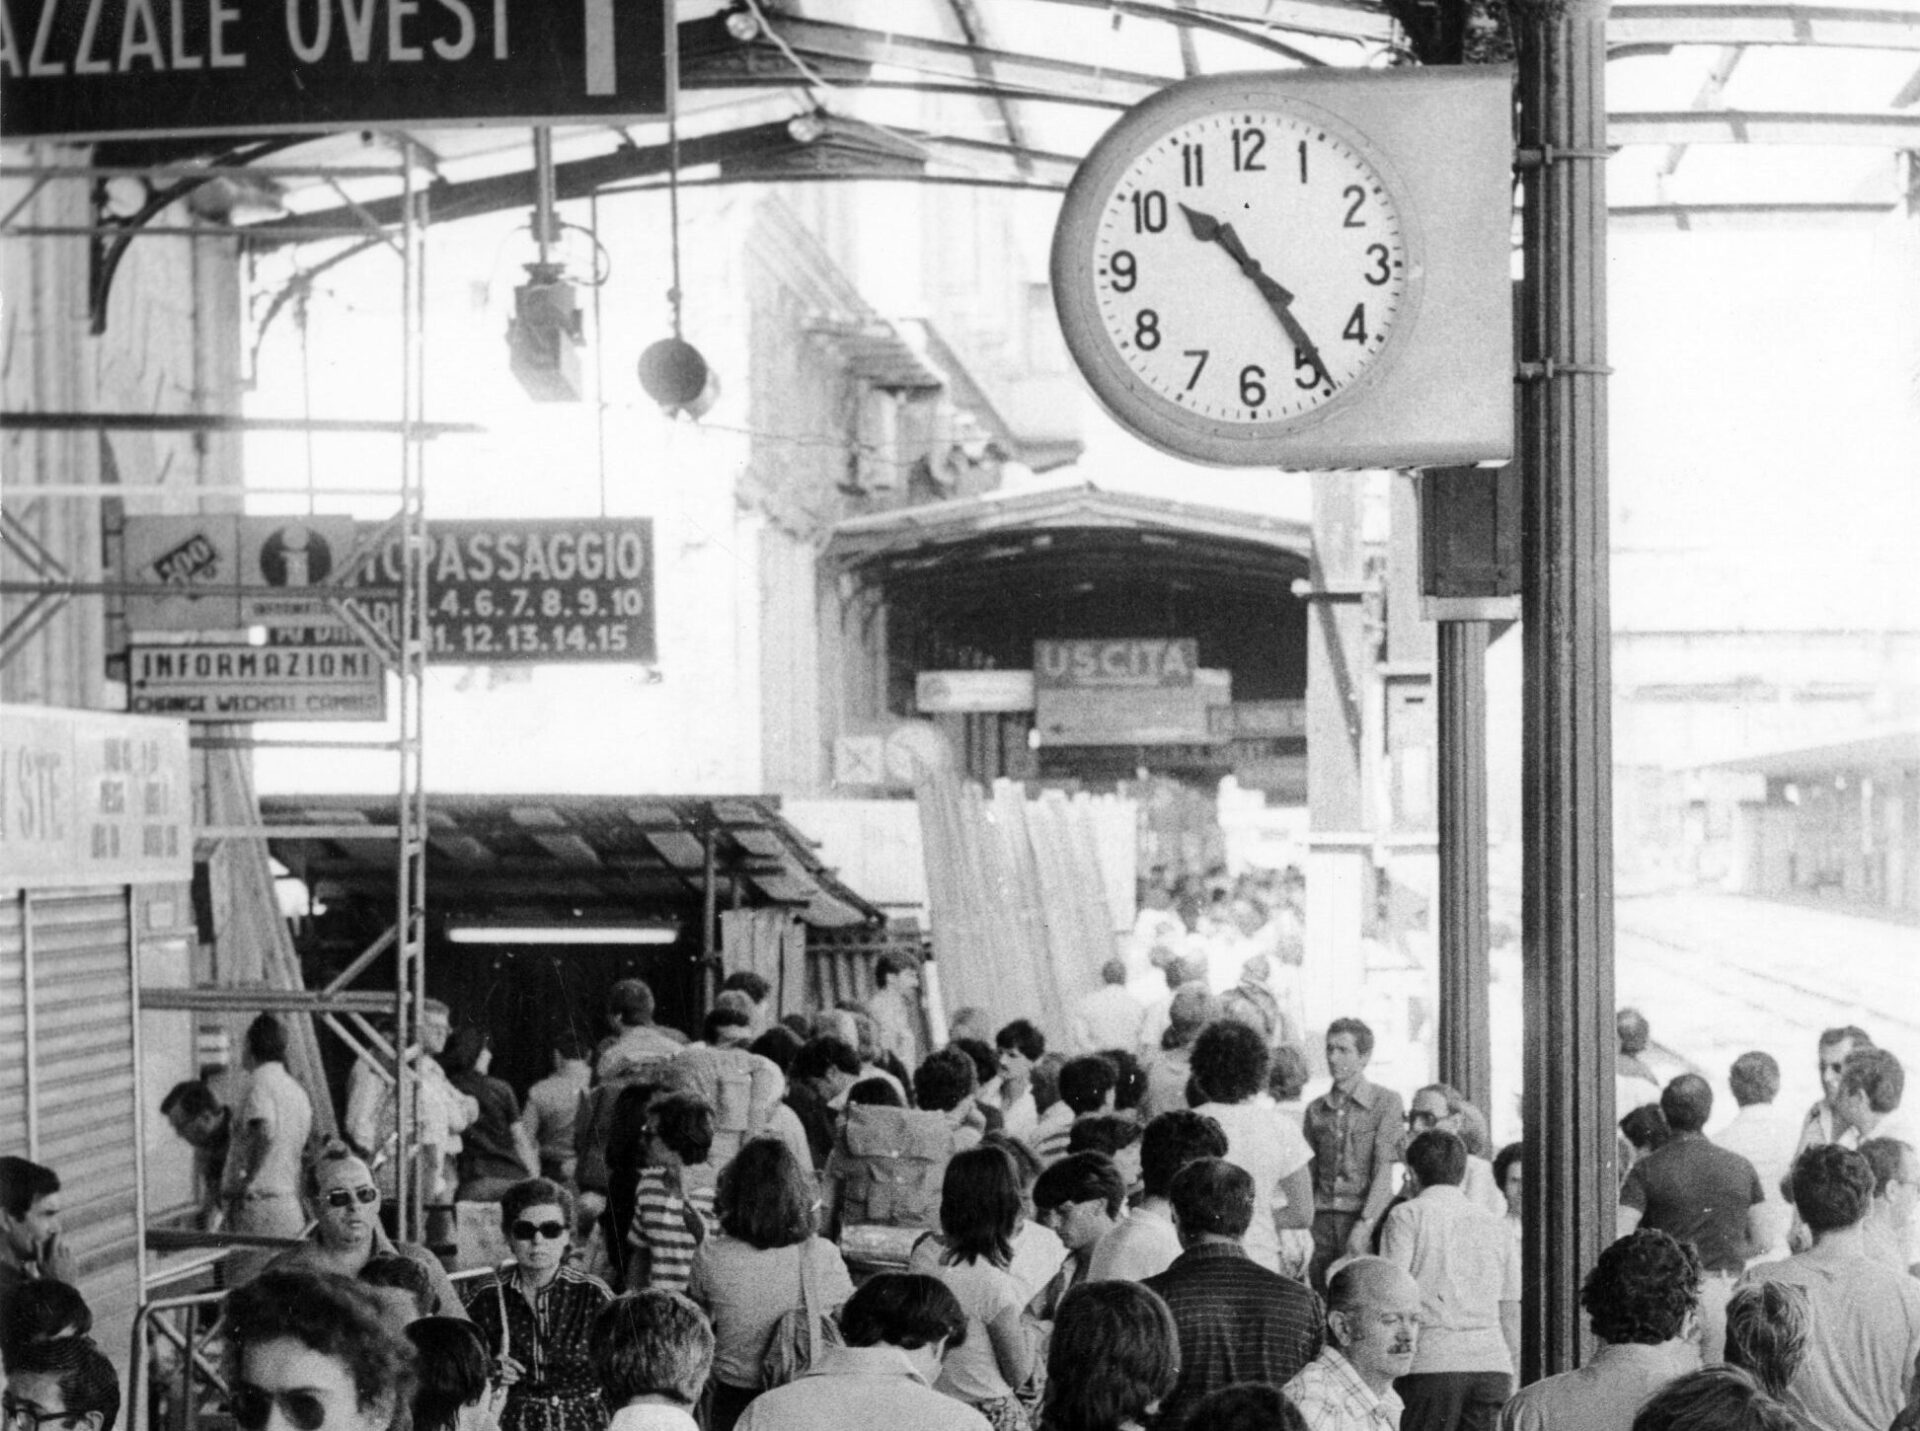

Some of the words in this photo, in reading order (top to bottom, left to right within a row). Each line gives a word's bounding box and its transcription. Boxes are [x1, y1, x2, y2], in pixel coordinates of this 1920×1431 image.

[1182, 143, 1204, 187] 11
[1231, 128, 1266, 172] 12
[1298, 140, 1308, 184] 1
[1131, 190, 1168, 234] 10
[1342, 185, 1367, 228] 2
[1110, 250, 1137, 293] 9
[1364, 243, 1391, 286] 3
[1134, 308, 1161, 351] 8
[1342, 302, 1368, 346] 4
[1183, 350, 1209, 391] 7
[1239, 364, 1266, 408] 6
[1294, 347, 1322, 390] 5
[143, 652, 370, 678] INFORMAZIONI
[1042, 643, 1190, 676] USCITA
